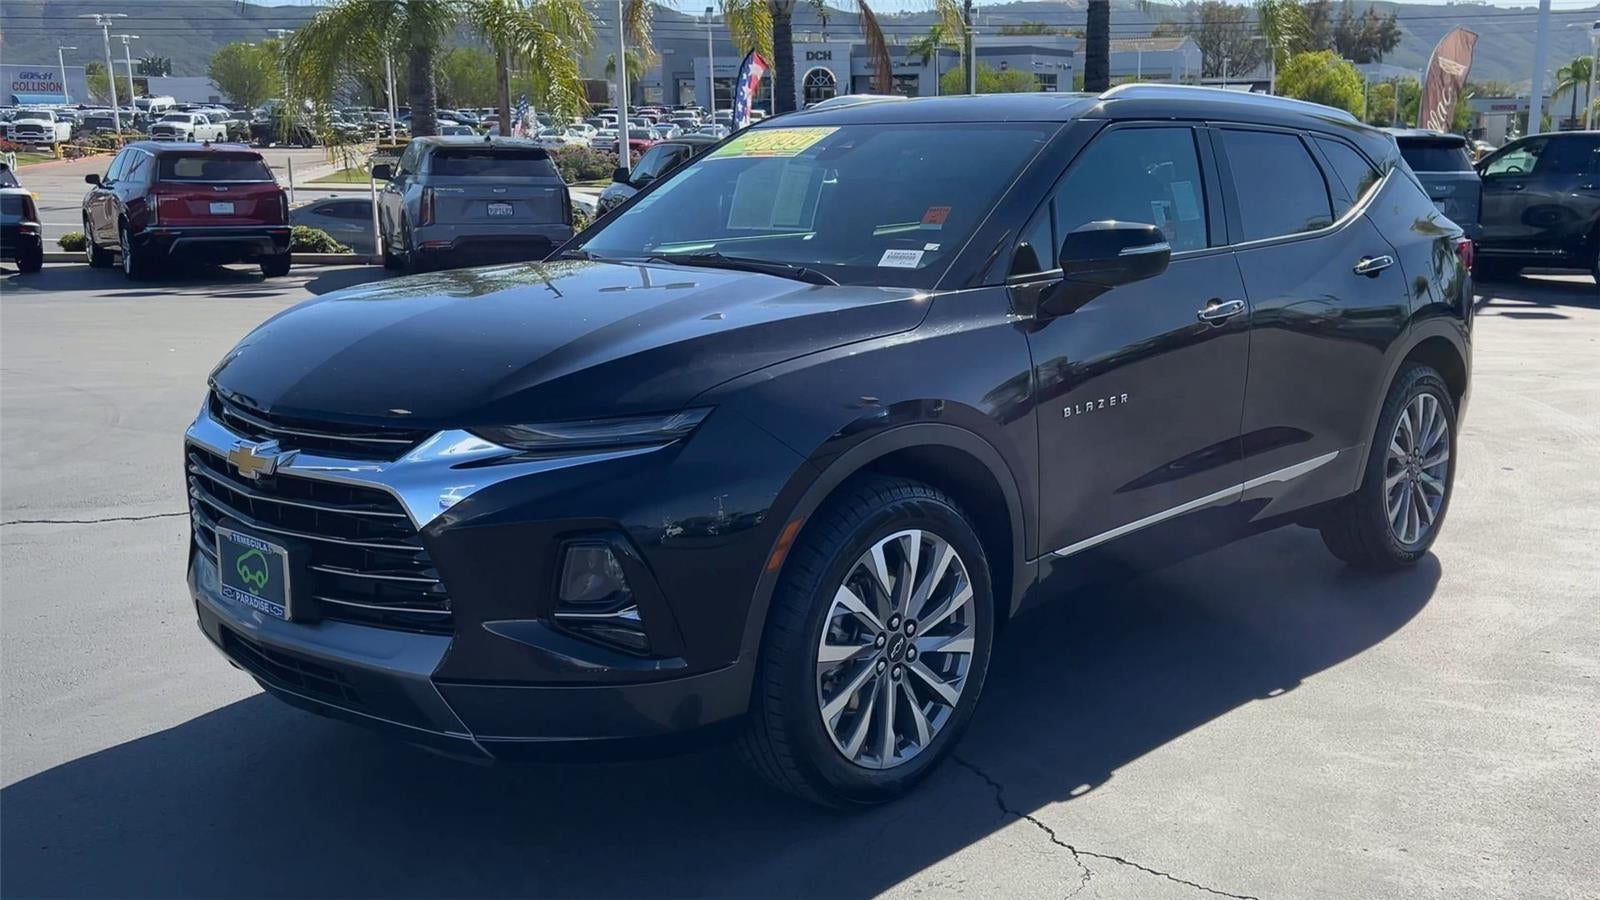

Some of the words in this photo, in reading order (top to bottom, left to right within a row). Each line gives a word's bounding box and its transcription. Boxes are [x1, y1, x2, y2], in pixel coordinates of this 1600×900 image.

[806, 50, 832, 61] DCH
[12, 81, 63, 91] COLLISION
[1063, 393, 1128, 418] BLAZER
[232, 532, 268, 552] TEMECULA
[236, 592, 270, 613] PARADISE
